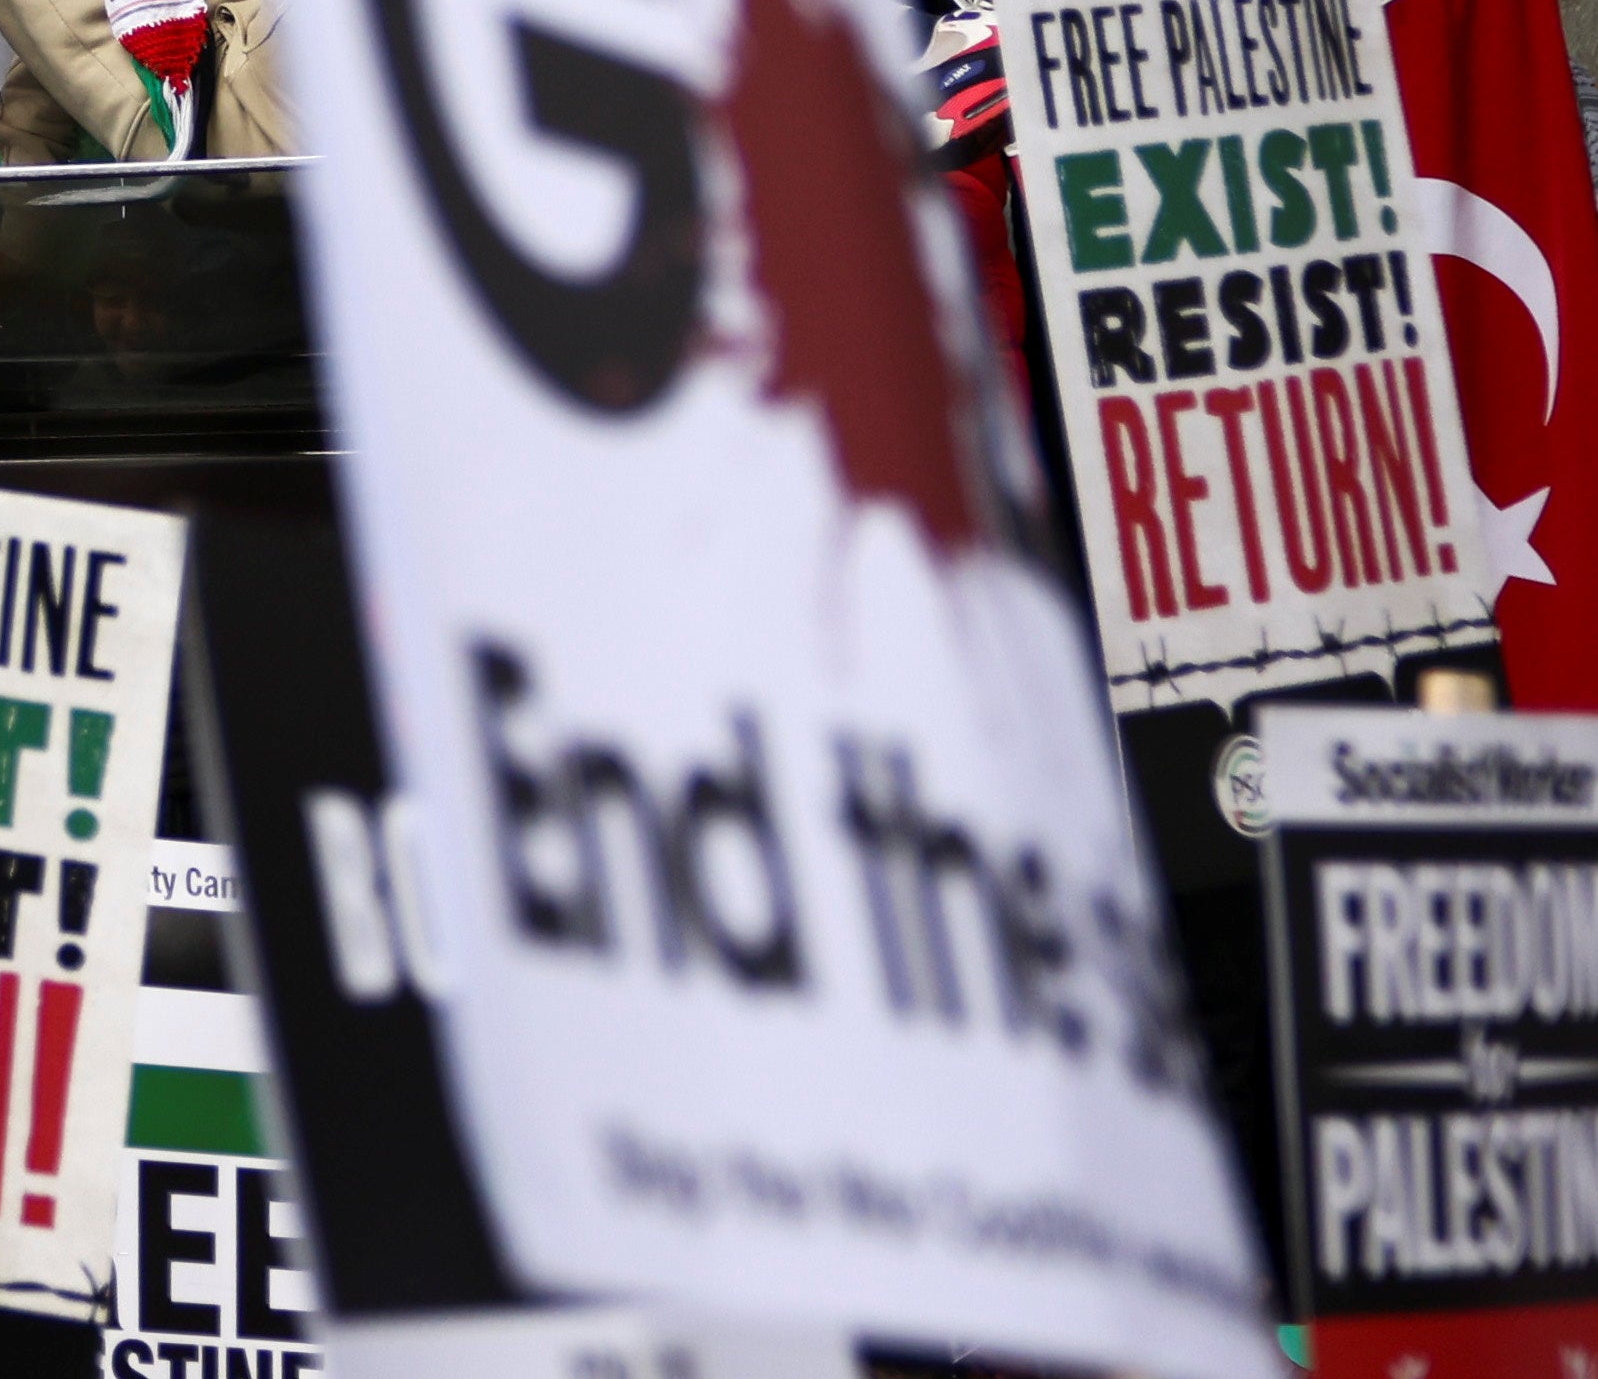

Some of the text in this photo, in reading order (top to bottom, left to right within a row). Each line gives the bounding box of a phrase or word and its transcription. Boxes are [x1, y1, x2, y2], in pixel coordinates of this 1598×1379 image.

[1031, 3, 1160, 128] FREE
[1055, 119, 1399, 273] EXIST!
[1079, 249, 1421, 388] RESIST!
[1098, 355, 1458, 622] RETURN!
[468, 630, 810, 999] End
[1314, 1115, 1598, 1281] PALESTIN
